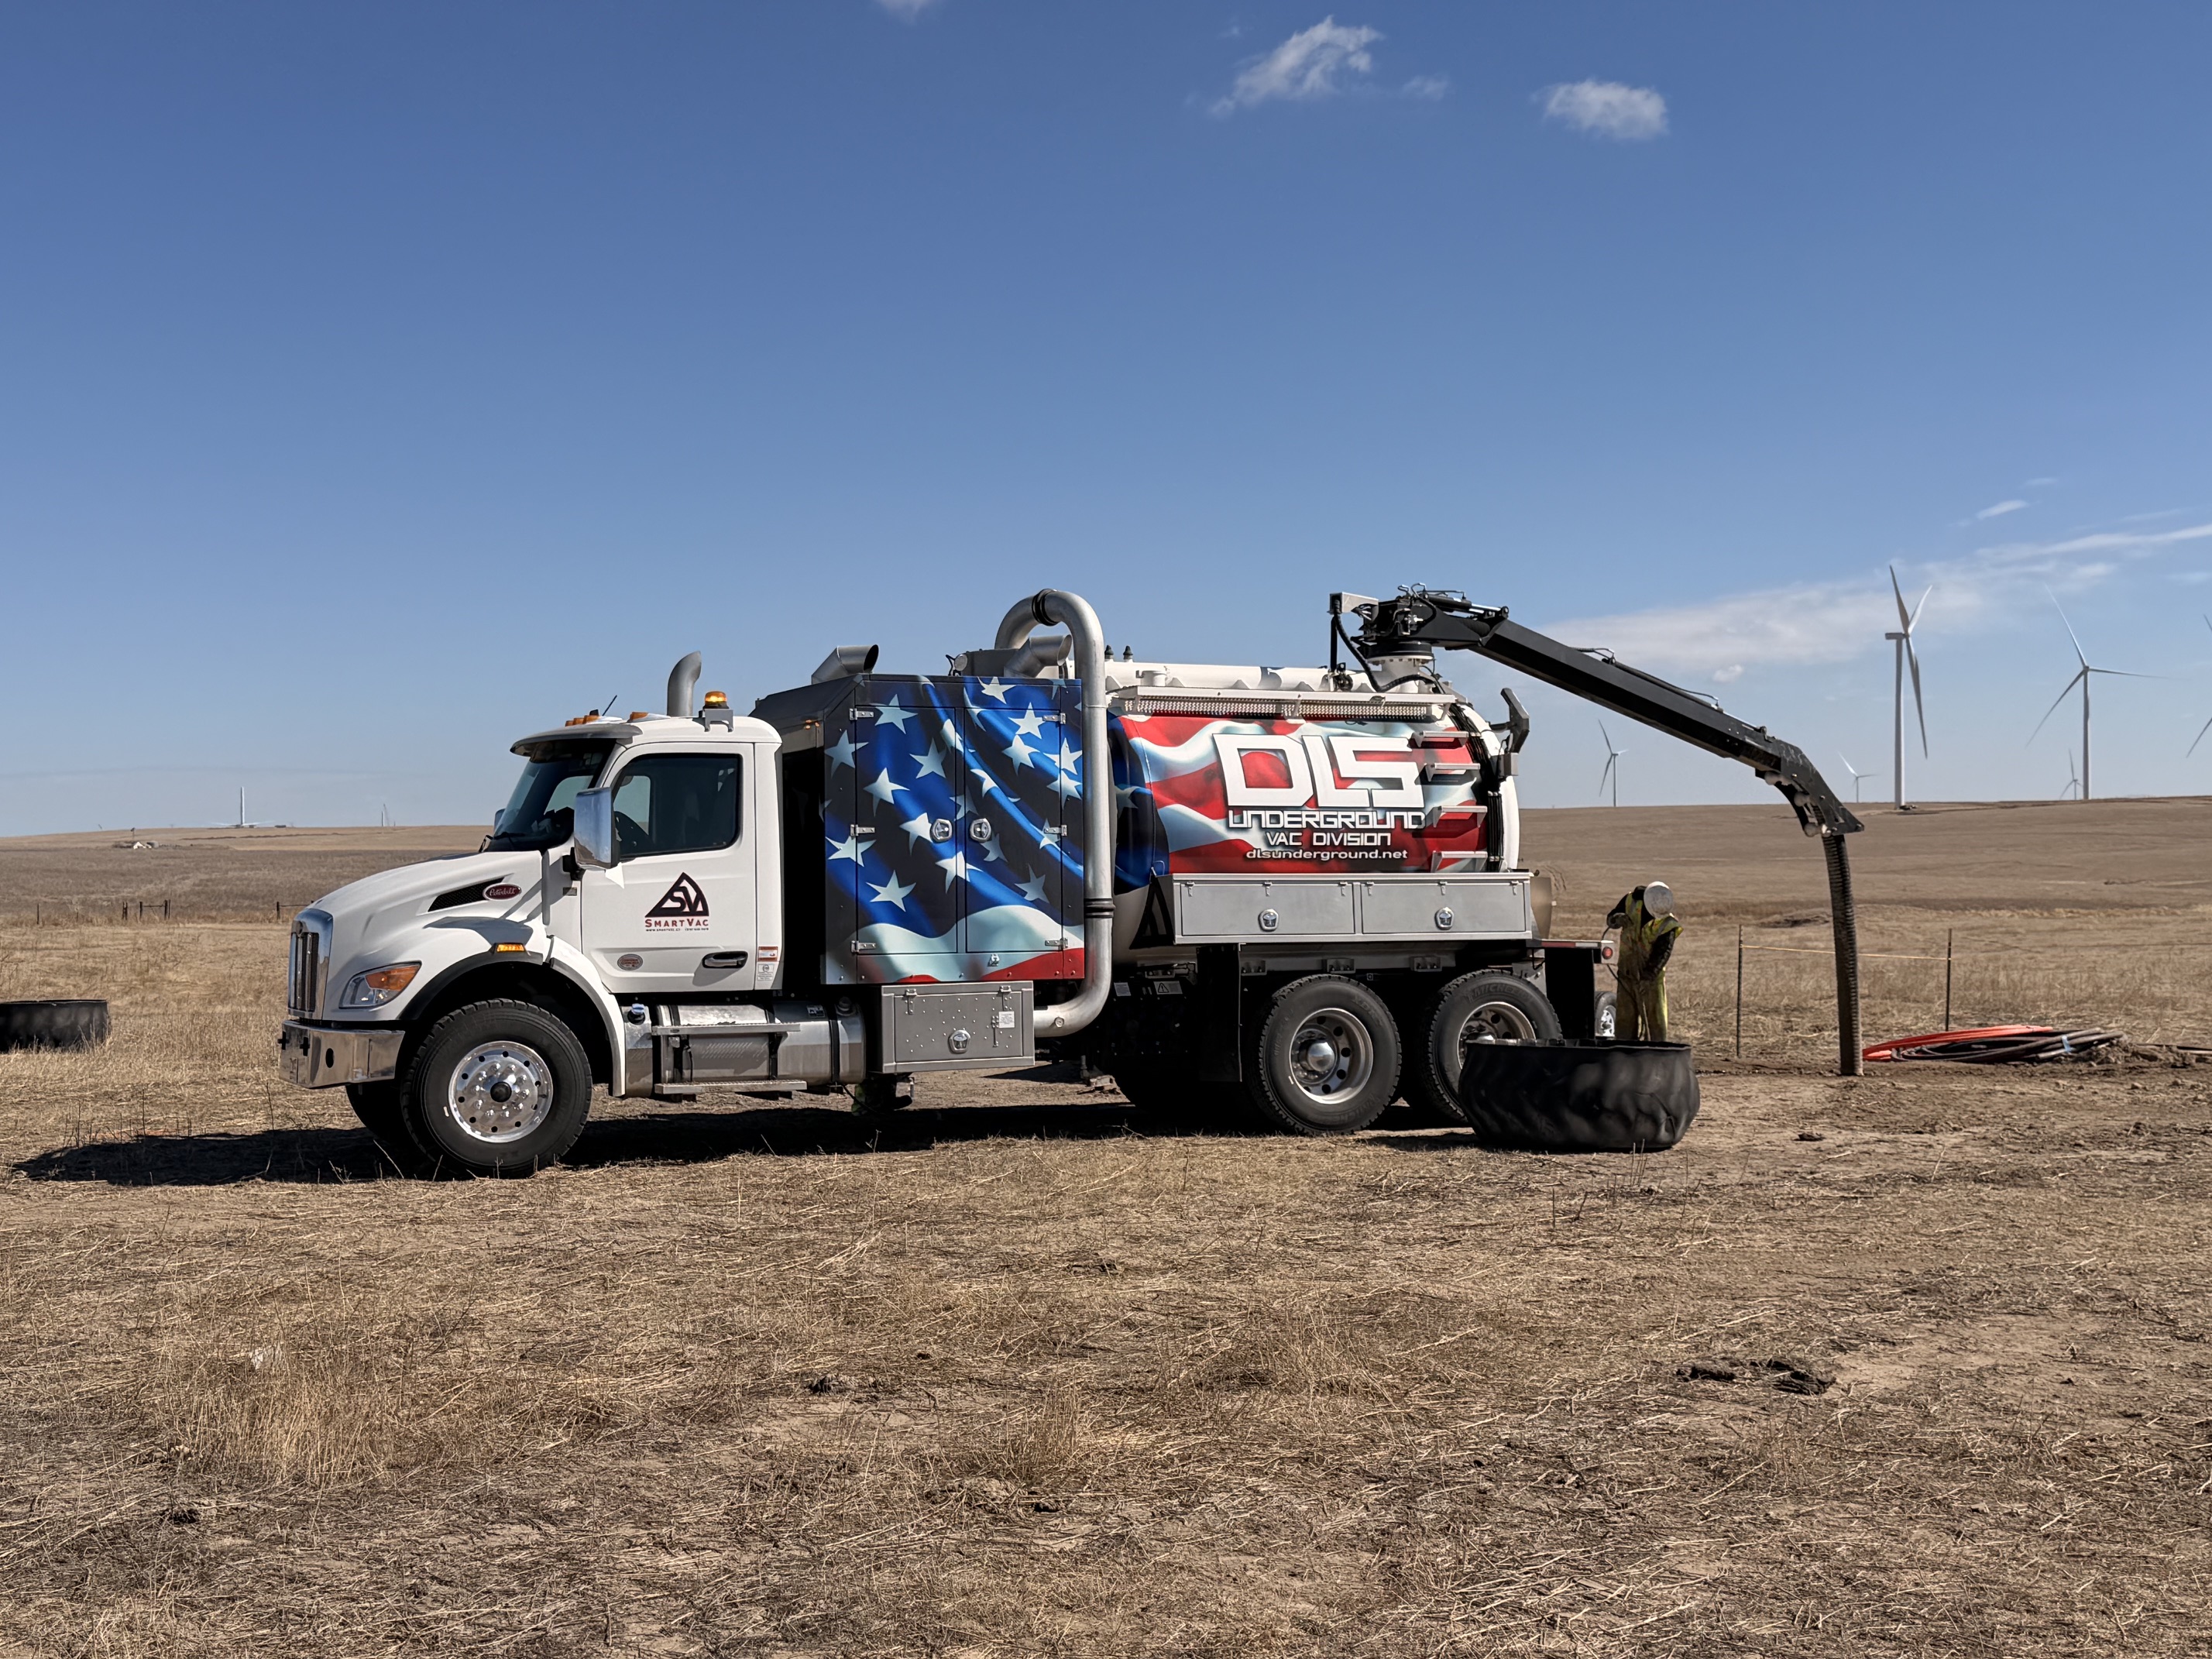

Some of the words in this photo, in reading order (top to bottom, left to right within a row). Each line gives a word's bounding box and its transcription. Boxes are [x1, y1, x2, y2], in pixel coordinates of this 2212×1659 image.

[1212, 733, 1424, 808] DLS
[1228, 810, 1426, 830] UNDERGROUND
[1266, 832, 1303, 847] VAC
[1312, 832, 1391, 847] DIVISION
[1245, 849, 1408, 861] dlsunderground.net
